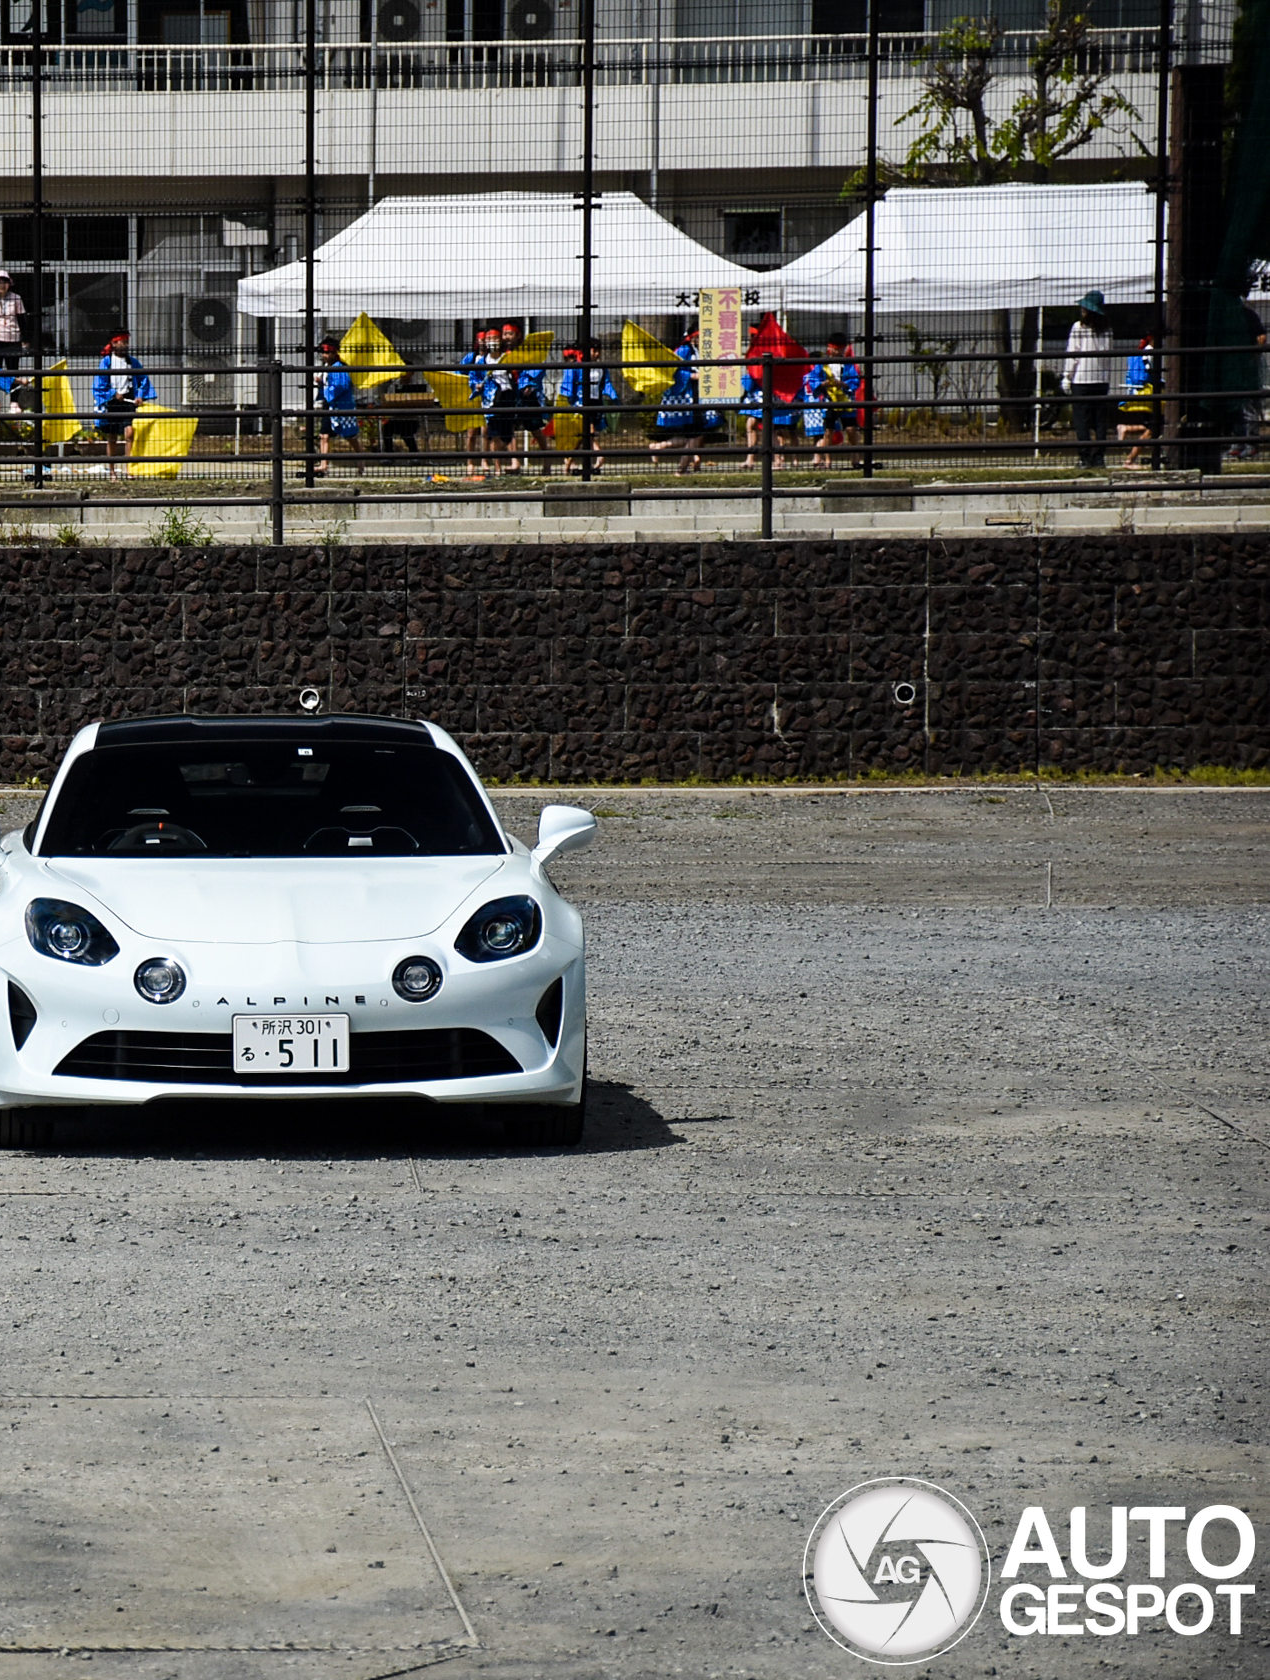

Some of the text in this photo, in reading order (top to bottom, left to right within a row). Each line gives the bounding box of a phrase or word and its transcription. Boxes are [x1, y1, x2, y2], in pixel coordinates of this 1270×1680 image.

[217, 995, 366, 1006] ALPINE
[262, 1019, 321, 1035] 所沢 301
[241, 1047, 255, 1062] る
